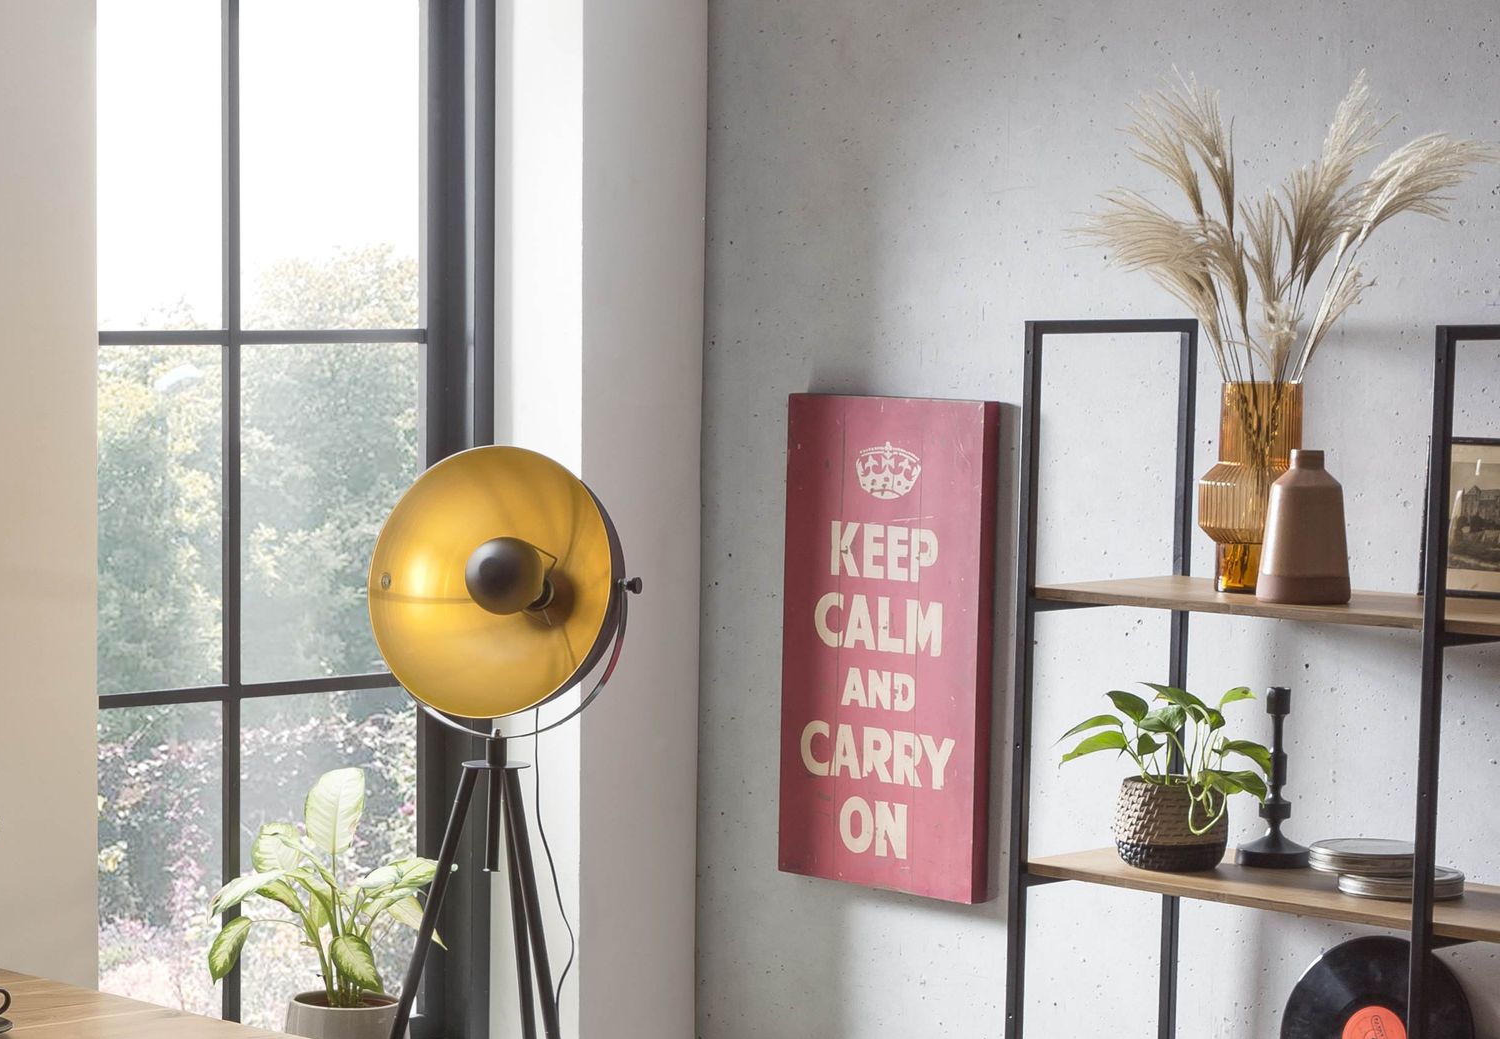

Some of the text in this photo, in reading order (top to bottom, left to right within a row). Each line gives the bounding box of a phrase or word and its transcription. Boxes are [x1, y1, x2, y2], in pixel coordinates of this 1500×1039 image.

[830, 520, 939, 582] KEEP
[814, 592, 943, 657] CALM
[841, 667, 916, 712] AND
[800, 720, 955, 790] CARRY
[839, 795, 908, 859] ON
